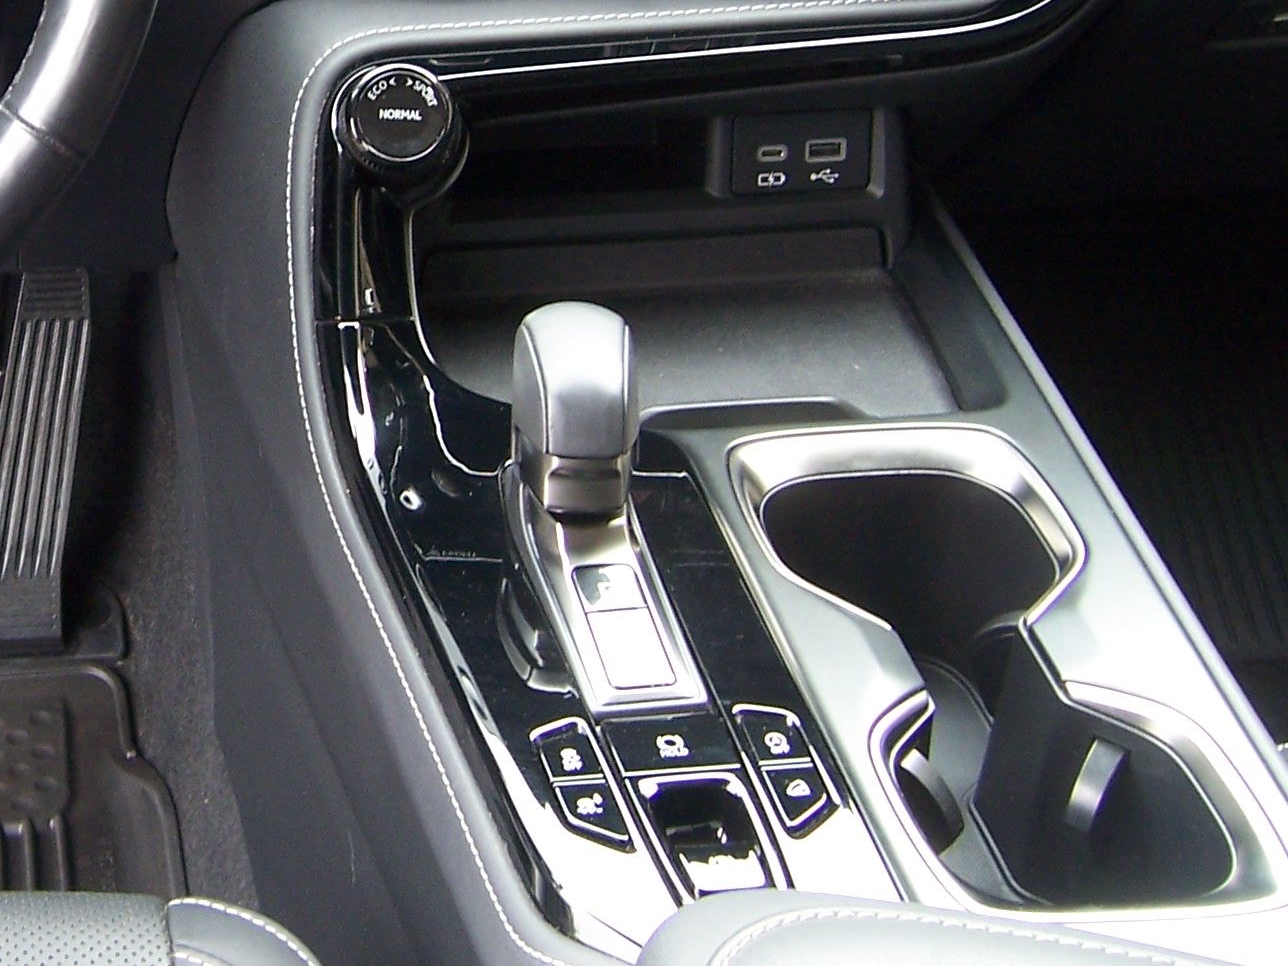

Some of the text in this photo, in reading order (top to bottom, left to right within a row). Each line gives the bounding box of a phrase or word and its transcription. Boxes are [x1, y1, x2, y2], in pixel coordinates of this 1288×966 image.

[367, 80, 388, 101] ECO
[413, 80, 438, 107] SPORT
[378, 108, 423, 121] NORMAL
